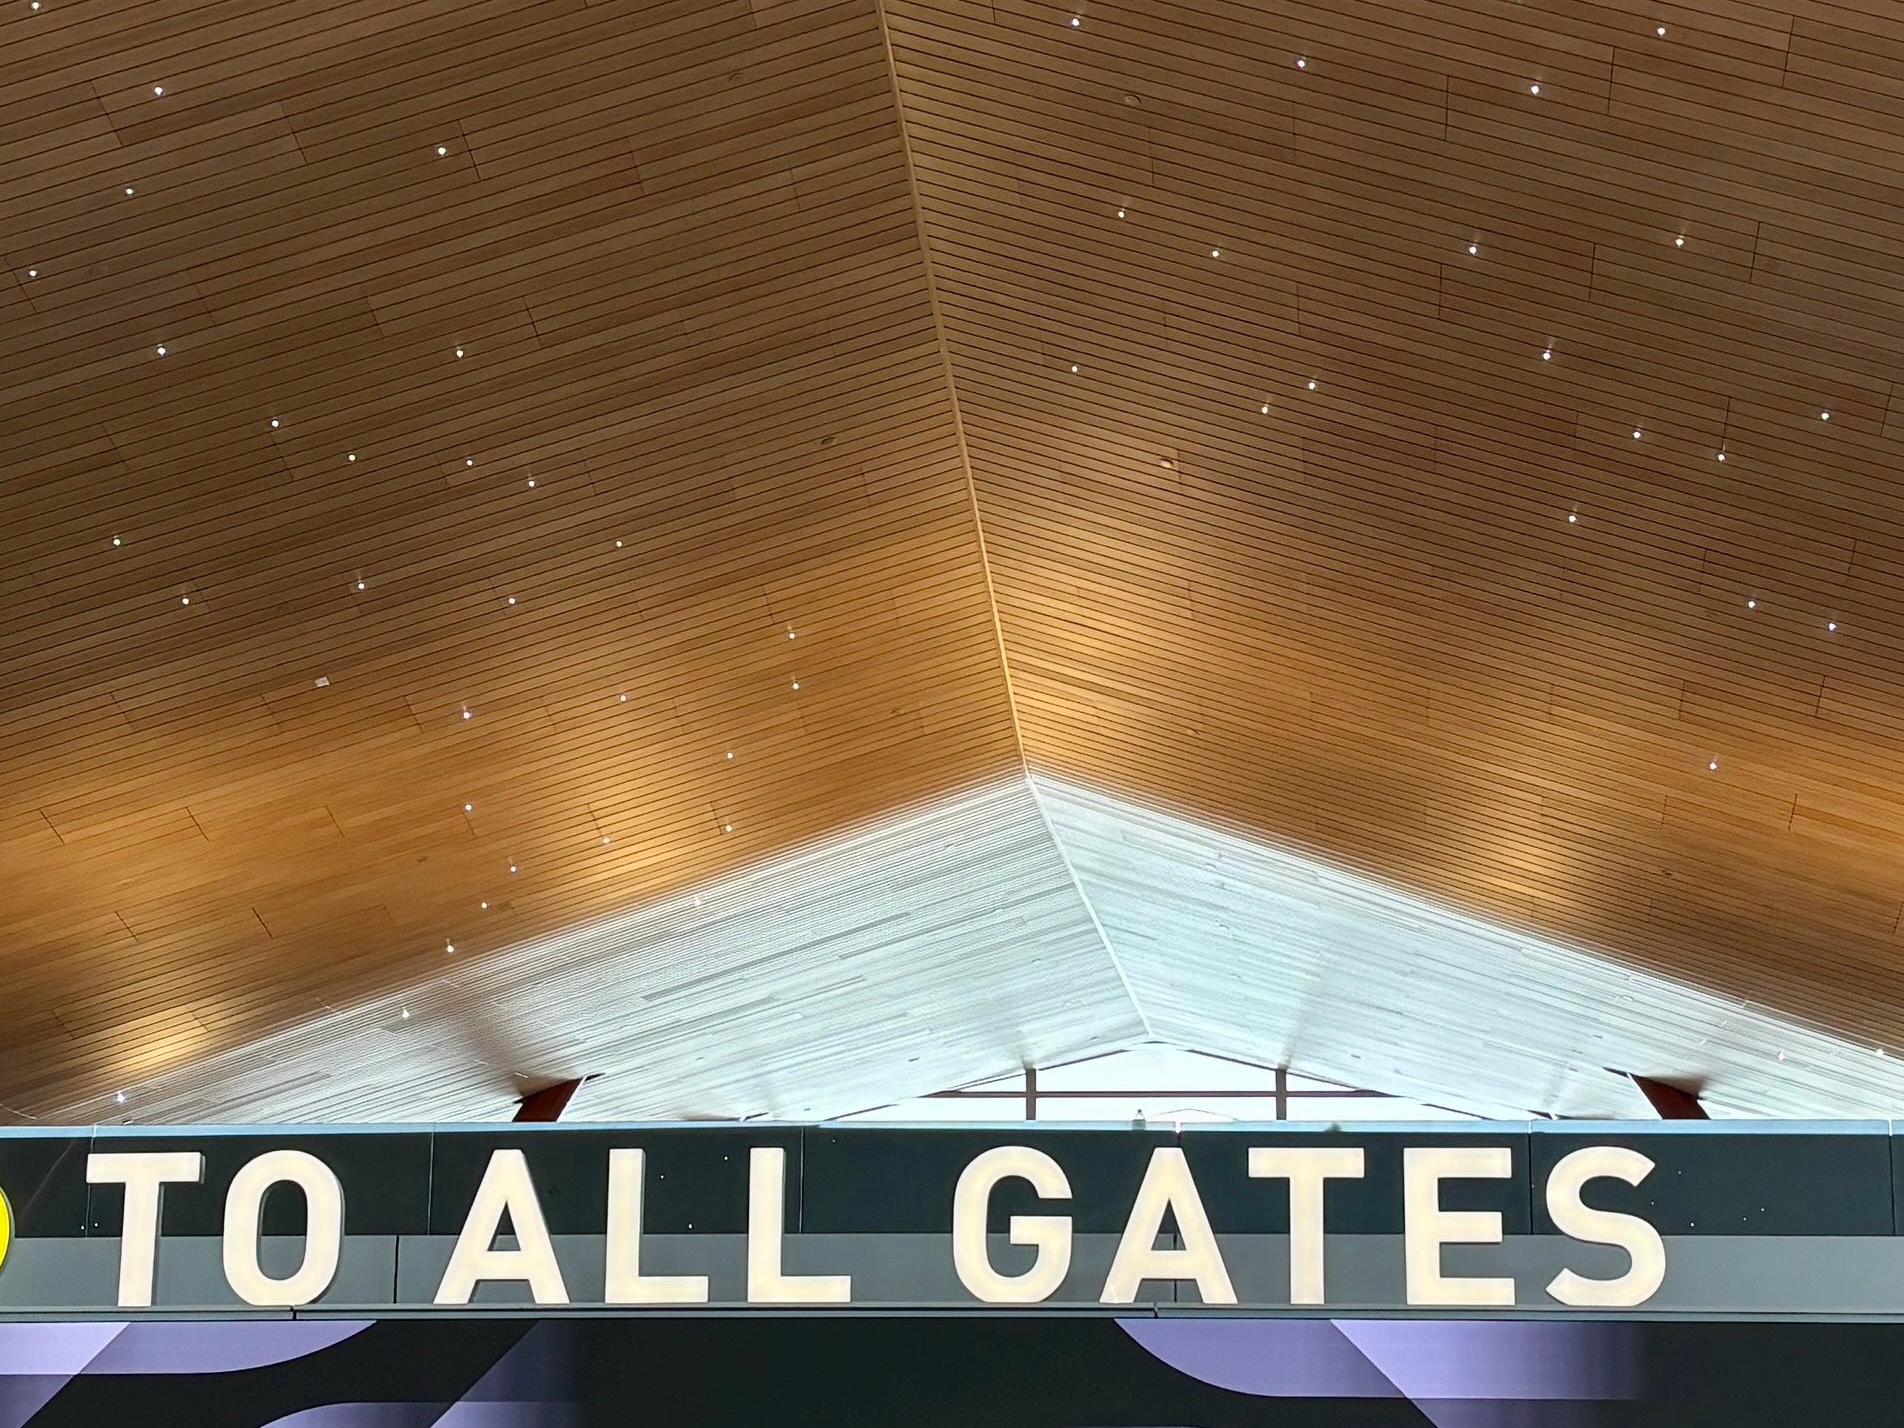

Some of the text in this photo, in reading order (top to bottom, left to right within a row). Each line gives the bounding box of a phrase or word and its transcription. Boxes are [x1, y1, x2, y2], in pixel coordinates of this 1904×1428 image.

[86, 1146, 1666, 1307] TO ALL GATES
